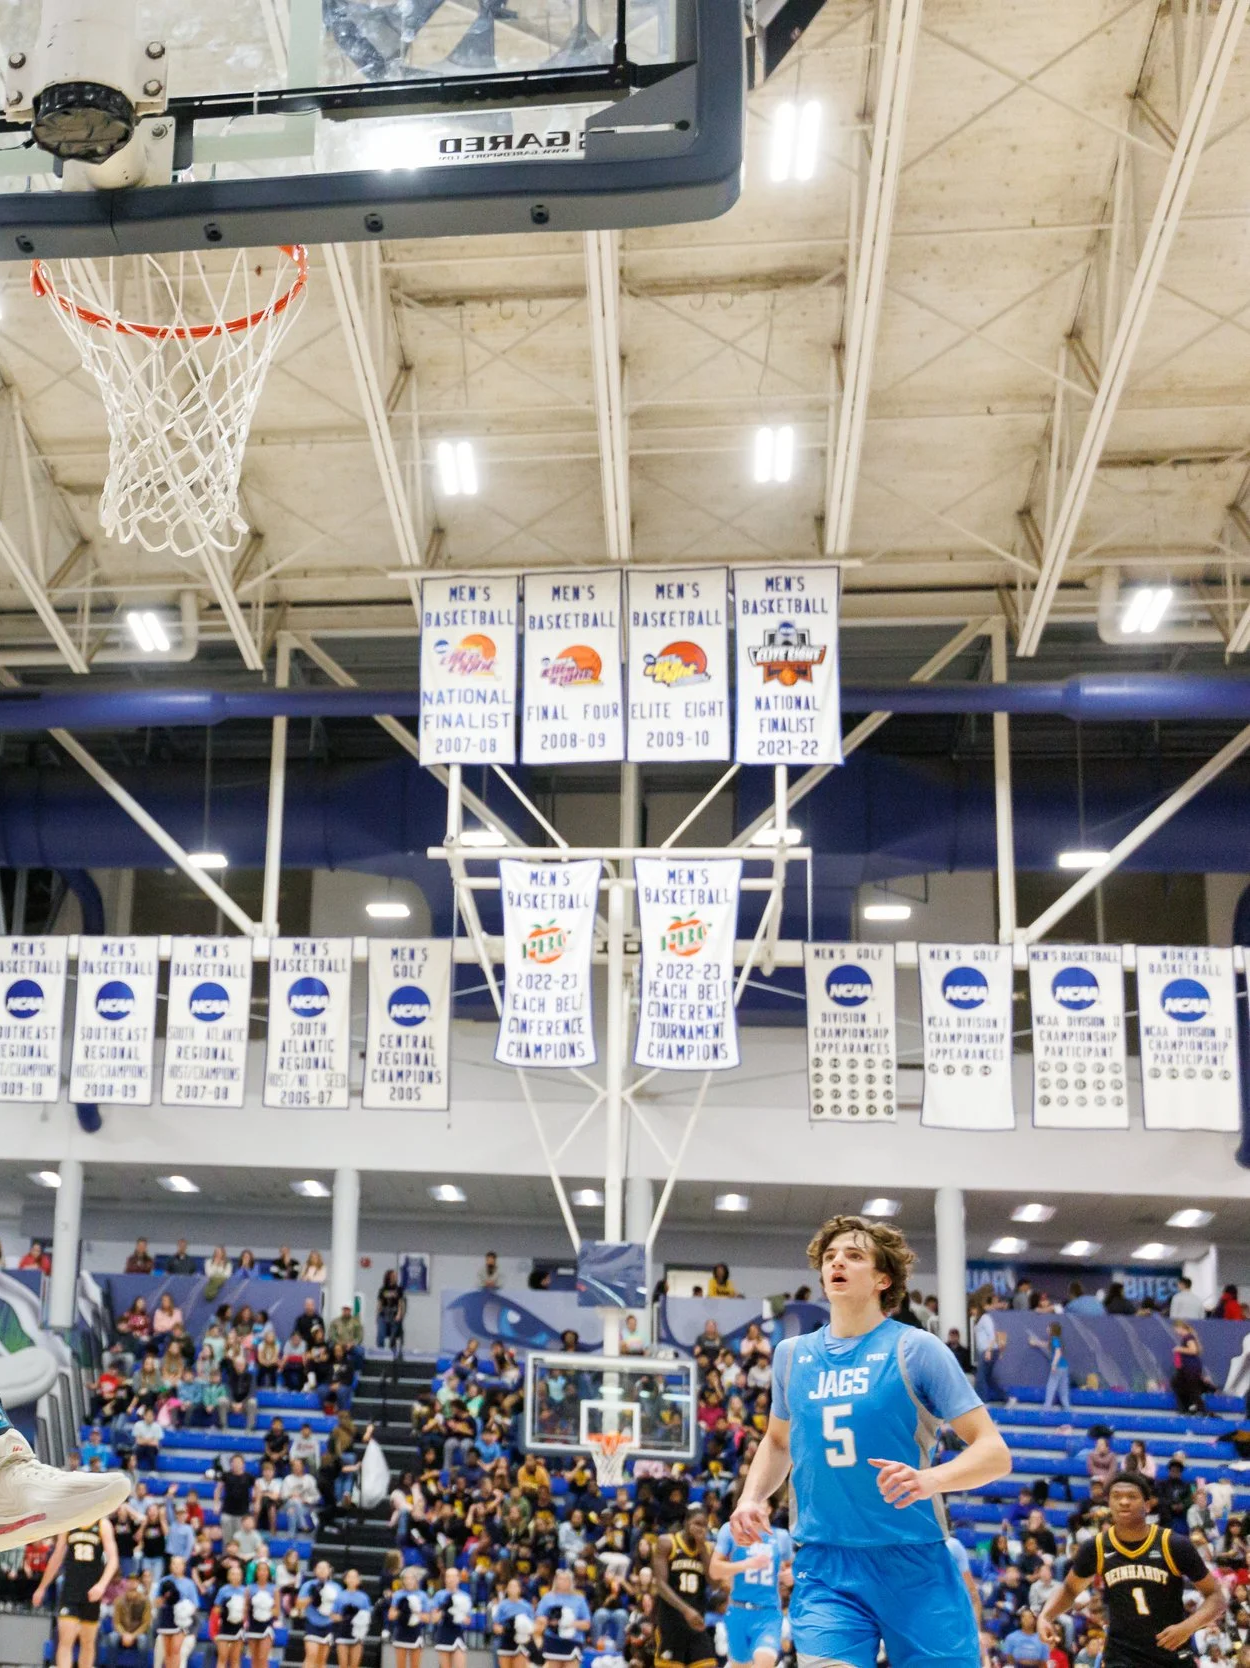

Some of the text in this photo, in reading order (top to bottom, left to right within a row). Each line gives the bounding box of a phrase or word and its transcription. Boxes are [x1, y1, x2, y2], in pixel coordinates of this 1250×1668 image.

[655, 583, 700, 599] MEN'S
[765, 576, 805, 592] MEN'S
[449, 585, 491, 601] MEN'S
[551, 585, 595, 601] MEN'S
[742, 598, 828, 615] BASKETBALL
[424, 610, 514, 628] BASKETBALL
[529, 611, 616, 630] BASKETBALL
[633, 610, 722, 627] BASKETBALL
[422, 688, 513, 706] NATIONAL
[755, 695, 820, 712] NATIONAL
[527, 702, 619, 721] FINAL FOUR
[630, 701, 724, 720] ELITE EIGHT
[424, 712, 511, 730] FINALIST
[759, 717, 815, 733] FINALIST
[435, 738, 497, 754] 2007-08
[541, 732, 606, 750] 2008-09
[646, 731, 709, 748] 2009-10
[757, 739, 819, 757] 2021-22
[530, 870, 570, 886] MEN'S
[668, 869, 708, 885] MEN'S
[508, 891, 589, 910] BASKETBALL
[645, 888, 730, 905] BASKETBALL
[11, 942, 46, 956] MEN'S
[101, 942, 136, 957] MEN'S
[194, 944, 230, 958] MEN'S
[292, 942, 329, 956] MEN'S
[390, 948, 428, 962] MEN'S
[814, 949, 884, 960] MEN'S GOLF
[929, 950, 999, 962] MEN'S GOLF
[1030, 951, 1119, 962] MEN'S BASKETBALL
[1161, 951, 1210, 962] WOMEN'S
[81, 960, 153, 976] BASKETBALL
[174, 963, 247, 979] BASKETBALL
[274, 958, 348, 974] BASKETBALL
[393, 964, 423, 979] GOLF
[656, 964, 720, 980] 2022-23
[1148, 964, 1222, 976] BASKETBALL
[517, 974, 577, 990] 2022-23
[828, 983, 873, 998] NCAA
[945, 985, 989, 1000] NCAA
[648, 1002, 727, 1019] CONFERENCE
[821, 1012, 866, 1024] DIVISION
[508, 1018, 583, 1035] CONFERENCE
[927, 1016, 950, 1028] NCAA
[957, 1017, 998, 1028] DIVISION
[1036, 1015, 1060, 1026] NCAA
[1067, 1015, 1105, 1026] DIVISION
[81, 1027, 148, 1041] SOUTHEAST
[206, 1026, 245, 1042] ATLANTIC
[290, 1023, 327, 1036] SOUTH
[651, 1022, 724, 1040] TOURNAMENT
[814, 1028, 889, 1040] CHAMPIONSHIP
[1040, 1030, 1117, 1041] CHAMPIONSHIP
[1144, 1026, 1169, 1037] NCAA
[1177, 1026, 1216, 1038] DIVISION
[281, 1039, 334, 1054] ATLANTIC
[379, 1034, 435, 1050] CENTRAL
[928, 1033, 1005, 1045] CHAMPIONSHIP
[1148, 1040, 1229, 1052] CHAMPIONSHIP
[84, 1046, 139, 1060] REGIONAL
[176, 1046, 234, 1061] REGIONAL
[507, 1042, 585, 1059] CHAMPIONS
[648, 1042, 728, 1060] CHAMPIONS
[814, 1043, 890, 1055] APPEARANCES
[930, 1049, 1004, 1061] APPEARANCES
[1044, 1046, 1113, 1057] PARTICIPANT
[279, 1056, 334, 1072] REGIONAL
[377, 1052, 436, 1068] REGIONAL
[1153, 1054, 1225, 1066] PARTICIPANT
[371, 1070, 442, 1084] CHAMPIONS
[176, 1085, 229, 1100] 2007-08
[280, 1090, 332, 1106] 2006-07
[389, 1086, 422, 1102] 2005
[1123, 1277, 1179, 1302] BITES
[808, 1367, 870, 1401] JAGS
[822, 1403, 857, 1469] 5
[1132, 1587, 1150, 1615] 1
